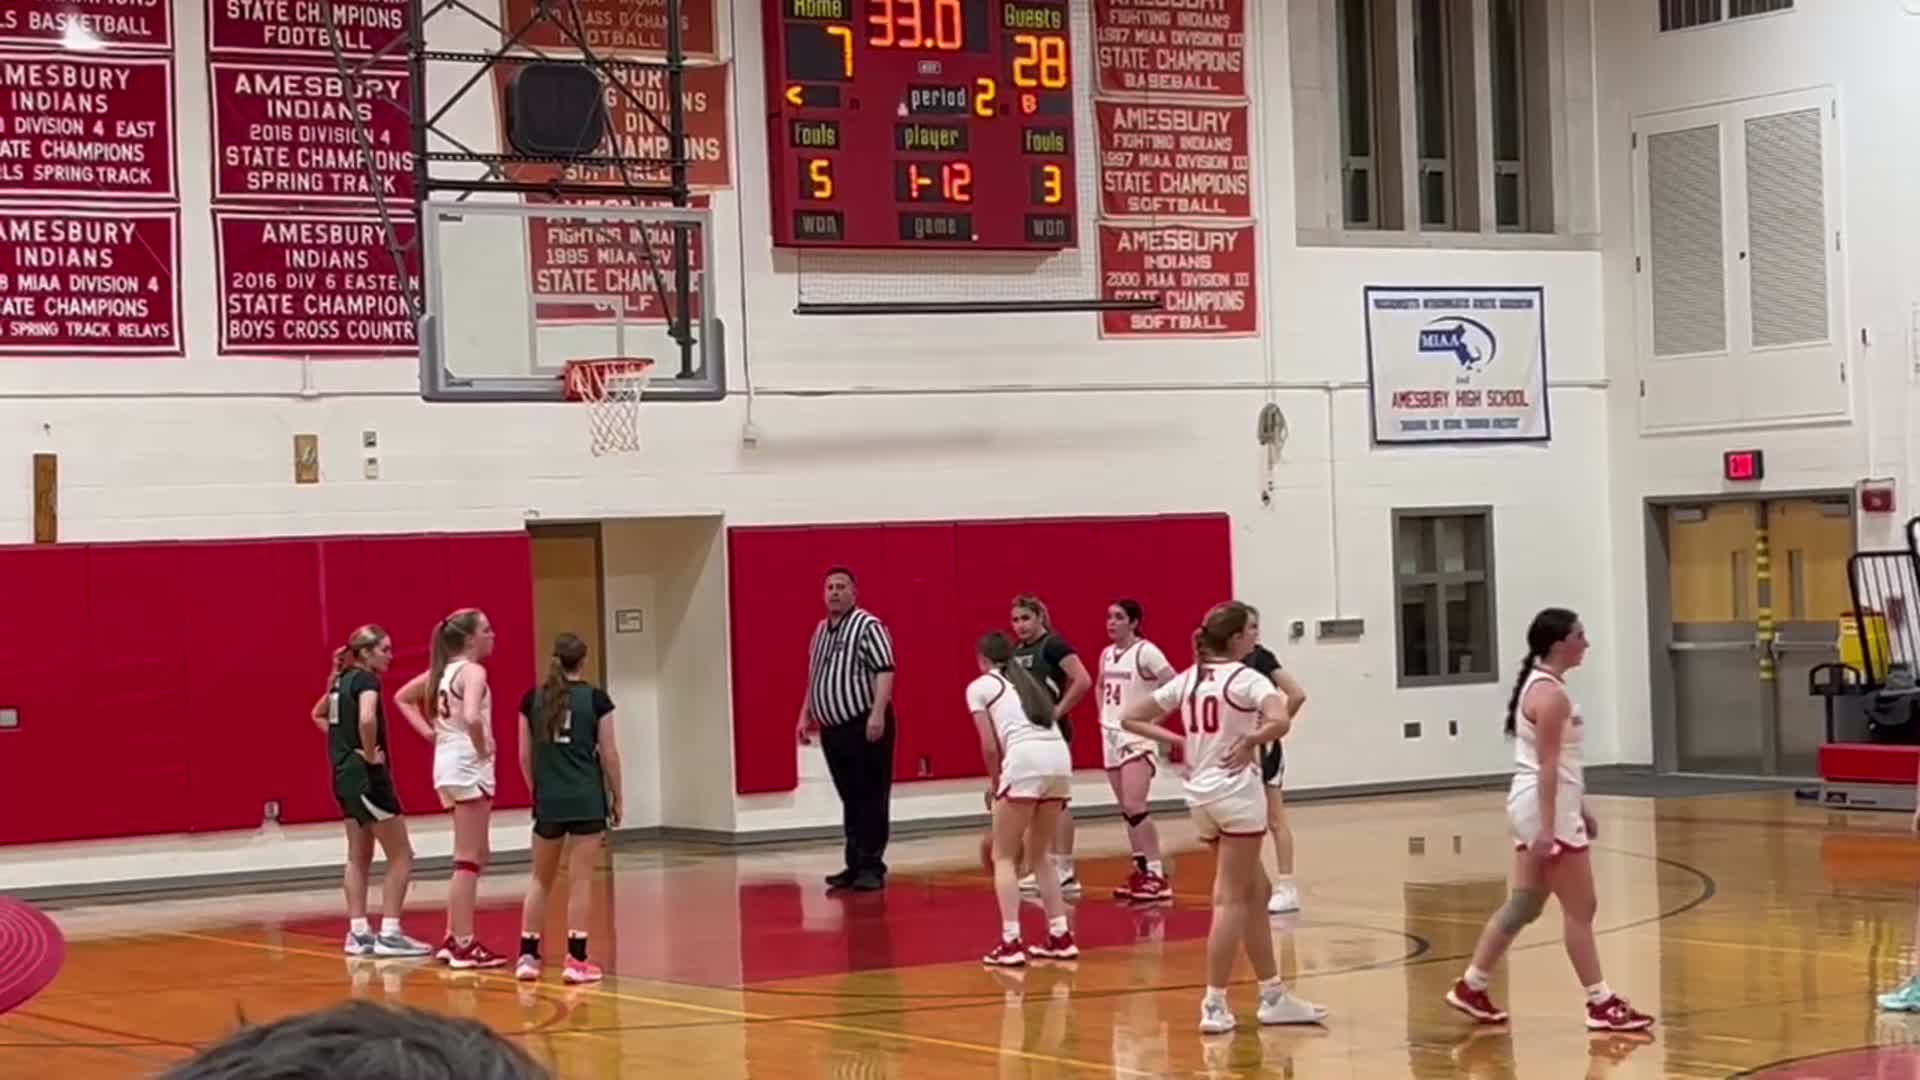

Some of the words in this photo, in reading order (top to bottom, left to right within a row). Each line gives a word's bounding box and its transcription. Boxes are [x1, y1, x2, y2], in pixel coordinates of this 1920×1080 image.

[227, 0, 289, 22] STATE
[295, 2, 403, 30] CHMPIONS
[1003, 3, 1063, 30] Guests
[560, 29, 662, 47] FOTBALL
[825, 25, 853, 78] 7
[1012, 34, 1068, 89] 28
[1101, 46, 1151, 70] STATE
[1156, 48, 1242, 73] CHAMPIONS
[0, 64, 130, 91] MESBURY
[1123, 72, 1221, 91] BASEBALL
[11, 90, 109, 114] INDIANS
[911, 88, 966, 110] period
[975, 77, 996, 117] 2
[267, 99, 374, 122] INDIANS
[1112, 107, 1232, 133] AMESBURY
[14, 116, 84, 136] DIVISION
[92, 119, 105, 137] 4
[115, 120, 156, 138] EAST
[249, 123, 293, 142] 2016
[380, 128, 391, 146] 4
[795, 124, 836, 146] fouls
[903, 124, 960, 150] player
[40, 139, 145, 163] CHAMPIONS
[1025, 131, 1064, 153] fouls
[226, 145, 290, 168] STATE
[0, 162, 24, 181] LS
[33, 163, 94, 183] SPRING
[95, 165, 153, 185] TRACK
[247, 170, 324, 191] SPRING
[331, 173, 397, 195] TRAK
[809, 158, 833, 199] 5
[1042, 164, 1062, 203] 3
[1104, 170, 1153, 193] STATE
[1159, 171, 1248, 196] CHAMPIONS
[1127, 195, 1227, 214] SOFTBALL
[261, 222, 388, 246] AMESBURY
[801, 214, 837, 234] won
[914, 215, 957, 239] game
[1032, 218, 1066, 237] won
[1117, 229, 1239, 253] AMESBURY
[15, 247, 114, 269] INDIANS
[284, 248, 370, 270] INDIANS
[1143, 253, 1213, 270] INDIANS
[17, 273, 62, 292] MIAA
[69, 275, 139, 294] DIVISION
[147, 276, 160, 293] 4
[232, 272, 277, 289] 2016
[286, 273, 316, 290] DIV
[325, 274, 336, 289] 6
[345, 274, 420, 292] EASTEN
[537, 268, 599, 292] STATE
[1105, 271, 1141, 288] 2000
[44, 297, 149, 318] CHAMPIONS
[228, 293, 293, 315] STATE
[1165, 290, 1246, 313] CHAMPIONS
[9, 321, 60, 337] SPRING
[65, 321, 112, 338] TRACK
[117, 323, 170, 339] RELAYS
[230, 319, 276, 340] BOYS
[283, 320, 340, 340] CROSS
[346, 320, 416, 341] COUNTR
[1130, 314, 1228, 330] SOFTBALL
[1421, 333, 1461, 348] MIAA
[1392, 390, 1450, 409] AMESBURY
[1456, 390, 1482, 408] HIGH
[1487, 389, 1529, 408] SCHOOL
[1105, 683, 1121, 707] 24
[1188, 695, 1219, 734] 10
